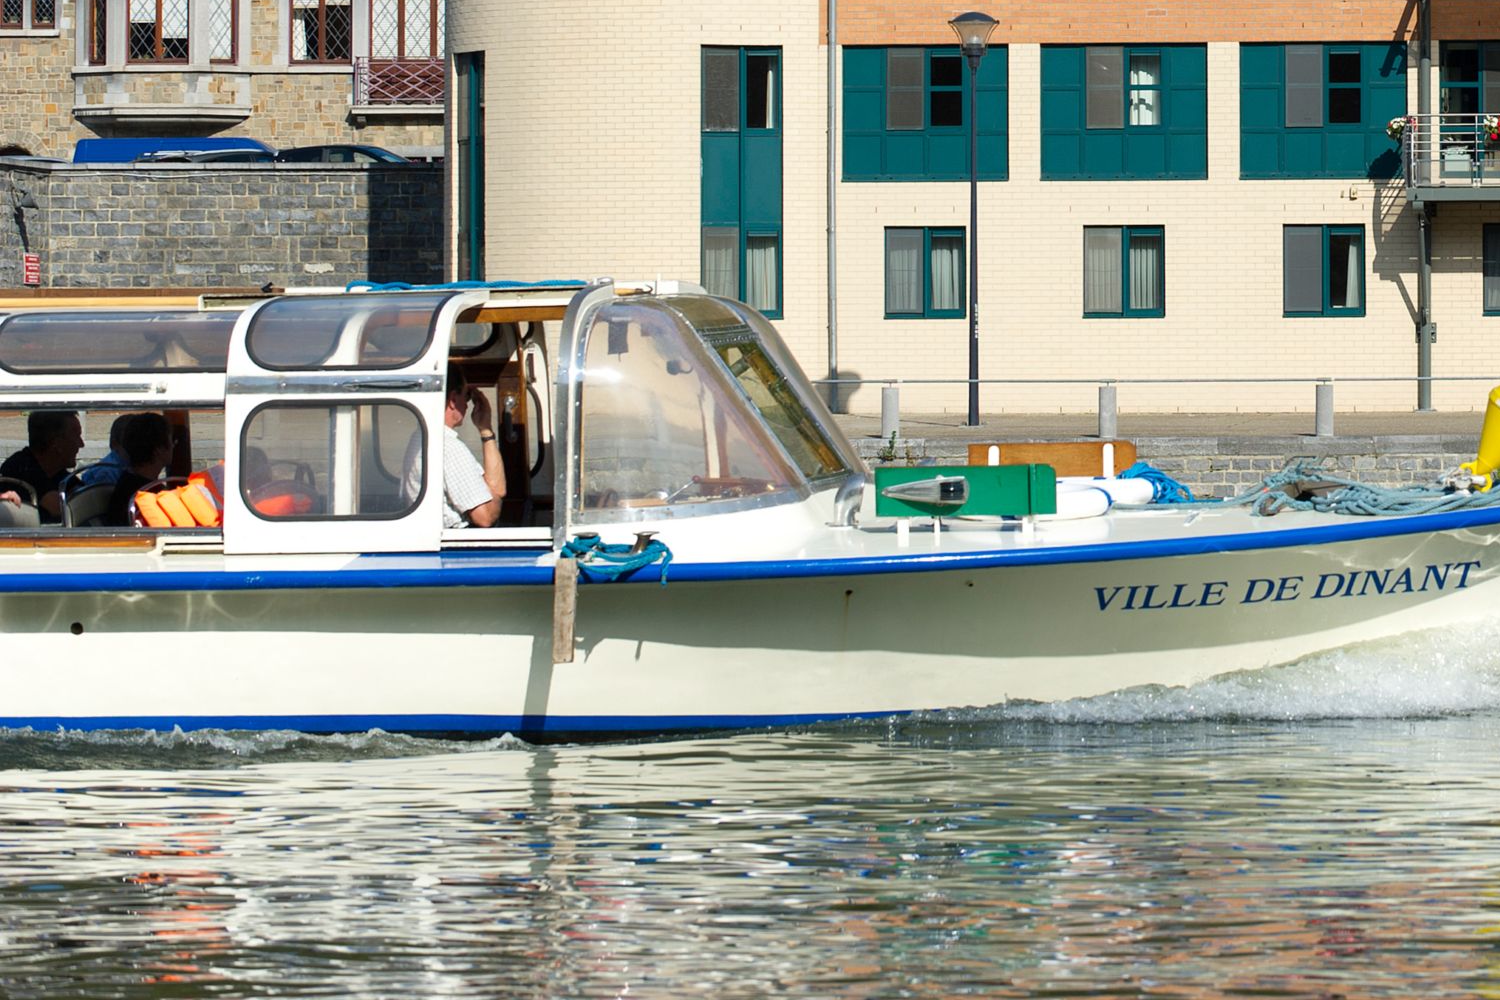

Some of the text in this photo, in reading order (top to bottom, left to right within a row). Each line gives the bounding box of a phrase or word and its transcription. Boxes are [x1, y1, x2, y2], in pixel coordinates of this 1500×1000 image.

[1094, 560, 1481, 611] VILLE DE DINANT
